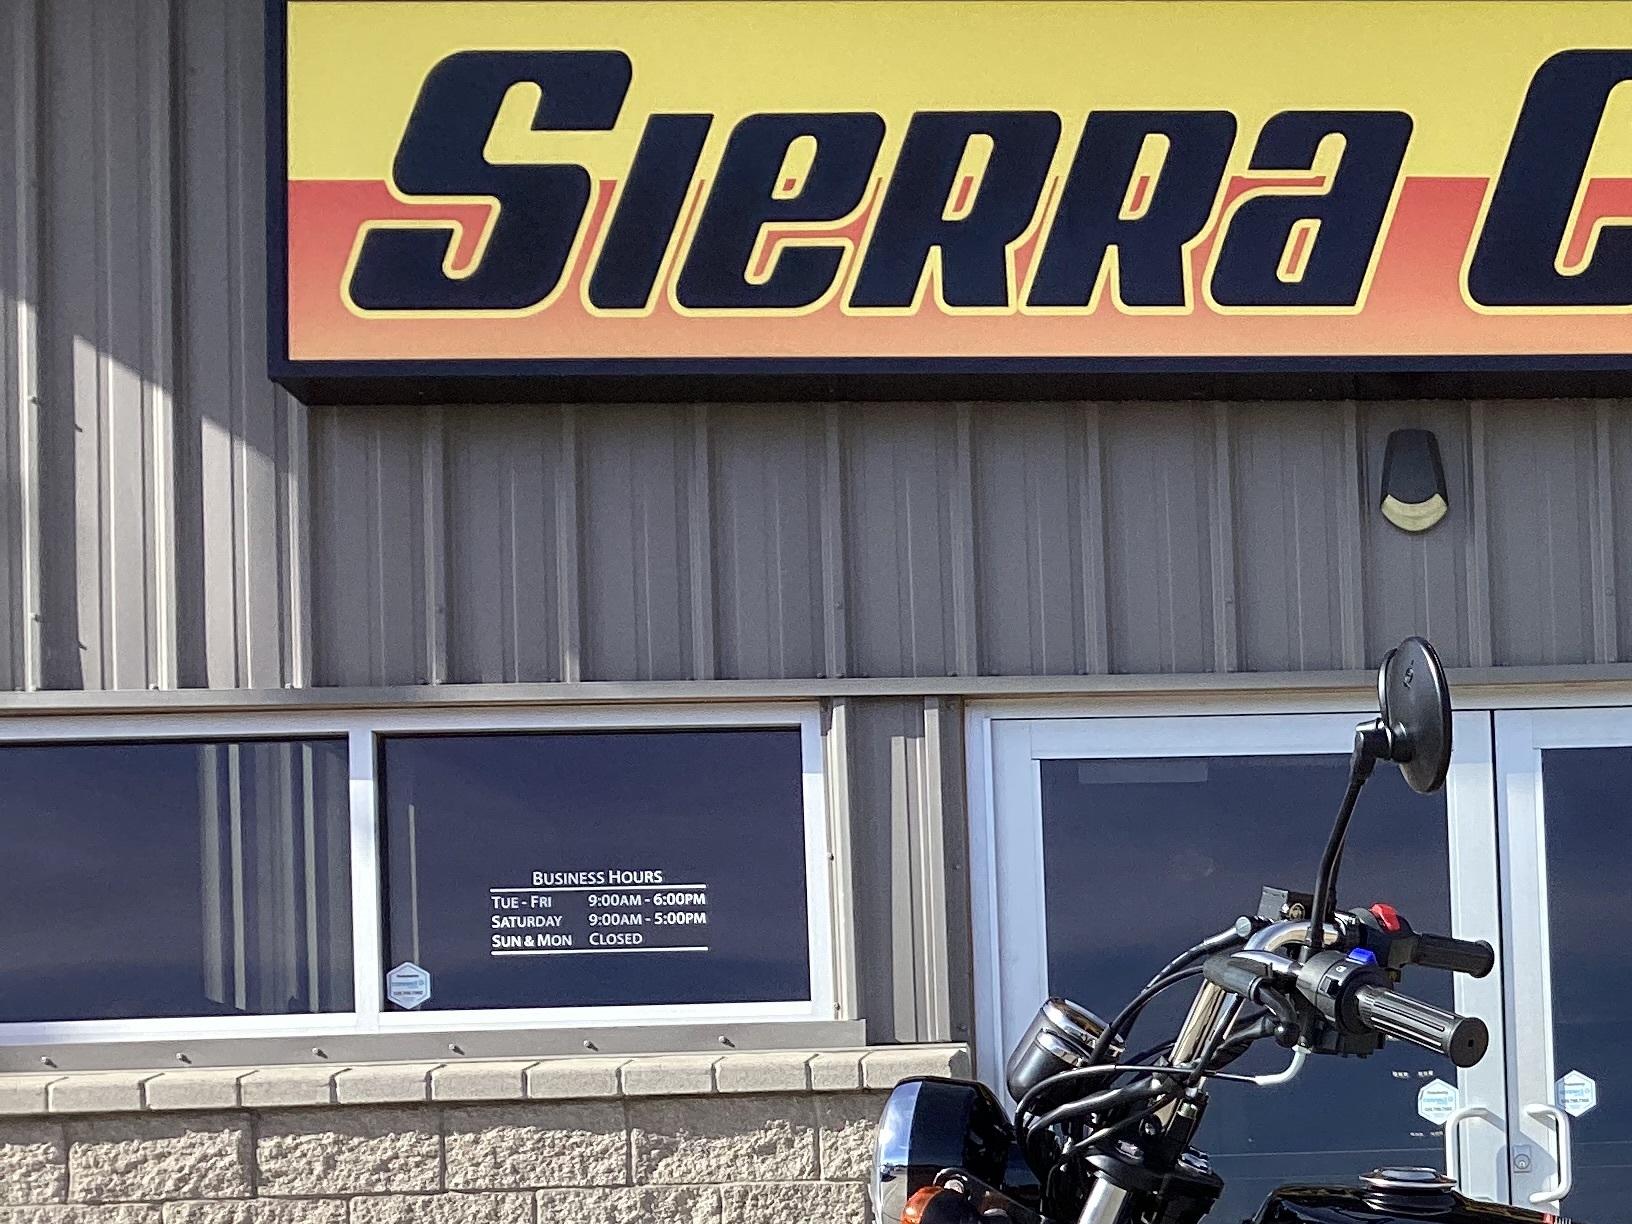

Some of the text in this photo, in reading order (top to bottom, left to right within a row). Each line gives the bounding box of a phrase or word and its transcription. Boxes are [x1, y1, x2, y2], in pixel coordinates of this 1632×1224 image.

[532, 869, 663, 886] BUSINESS HOURS
[491, 895, 519, 909] TUE
[530, 895, 552, 908] FRI
[588, 894, 642, 907] 9:00AM
[653, 892, 706, 906] 6:00PM
[491, 915, 563, 929] SATURDAY
[588, 913, 642, 926] 9:00AM
[654, 911, 707, 925] 5:00PM
[491, 933, 573, 948] SUN & MON
[589, 932, 643, 946] CLOSED
